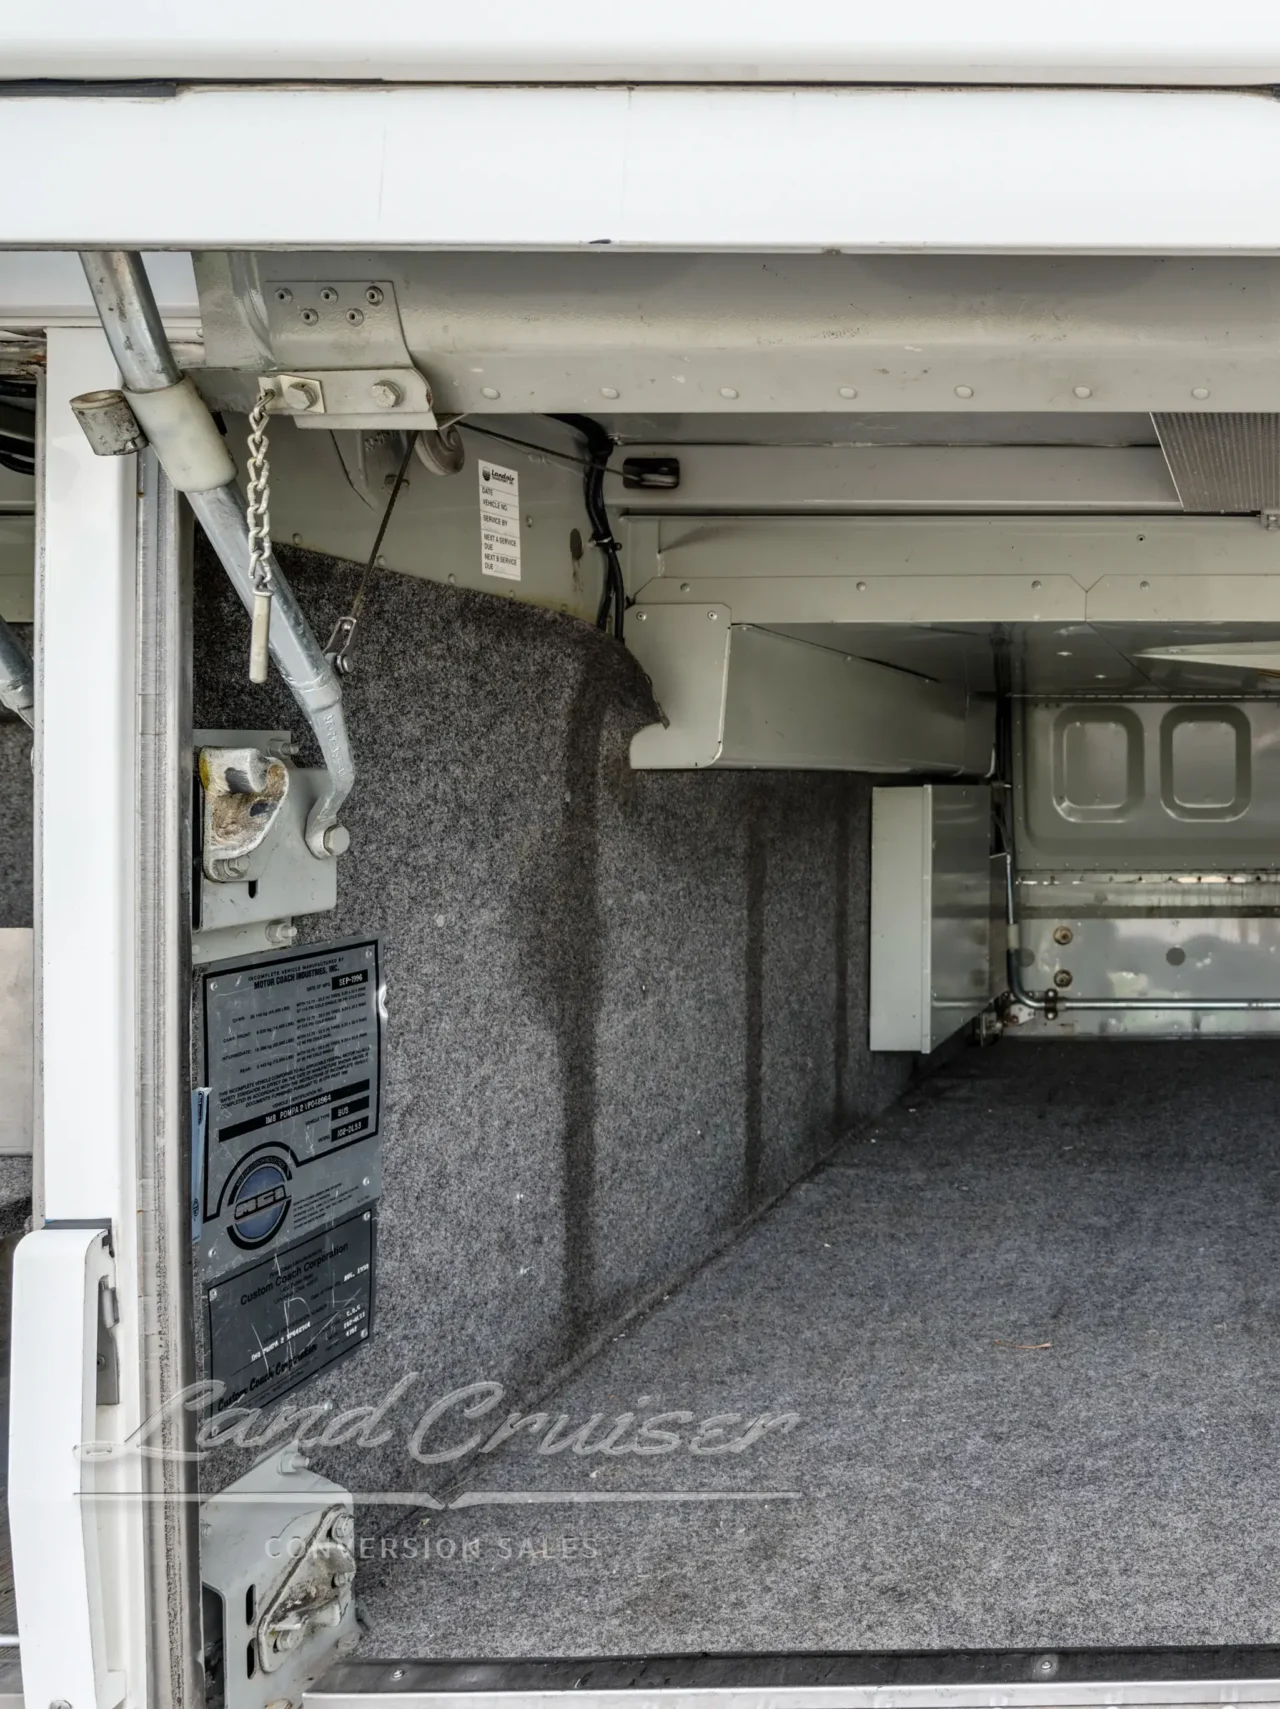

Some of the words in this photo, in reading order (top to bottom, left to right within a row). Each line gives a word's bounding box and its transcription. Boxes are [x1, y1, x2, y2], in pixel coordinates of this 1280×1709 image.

[492, 469, 514, 481] Landair
[482, 487, 493, 496] DATE
[482, 498, 500, 510] VEHICLE
[483, 514, 501, 525] SERVICE
[484, 534, 495, 542] NEXT
[499, 537, 516, 547] SERVICE
[484, 542, 493, 551] DUE
[484, 553, 496, 562] NEXT
[500, 556, 517, 566] SERVICE
[485, 561, 494, 570] DUE
[248, 971, 280, 982] INCOMPLETE
[302, 959, 337, 970] MANUFACTURED
[254, 979, 275, 990] MOTOR
[276, 974, 295, 985] COACH
[296, 967, 327, 981] INDUSTRIES,
[329, 964, 340, 973] INC.
[339, 974, 363, 987] SEP-1996
[338, 1106, 349, 1118] BUS
[234, 1184, 287, 1221] MCI
[240, 1282, 273, 1306] Custom
[275, 1267, 301, 1287] Coach
[304, 1242, 348, 1272] Corporation
[218, 1387, 248, 1412] Custom
[250, 1366, 275, 1392] Coach
